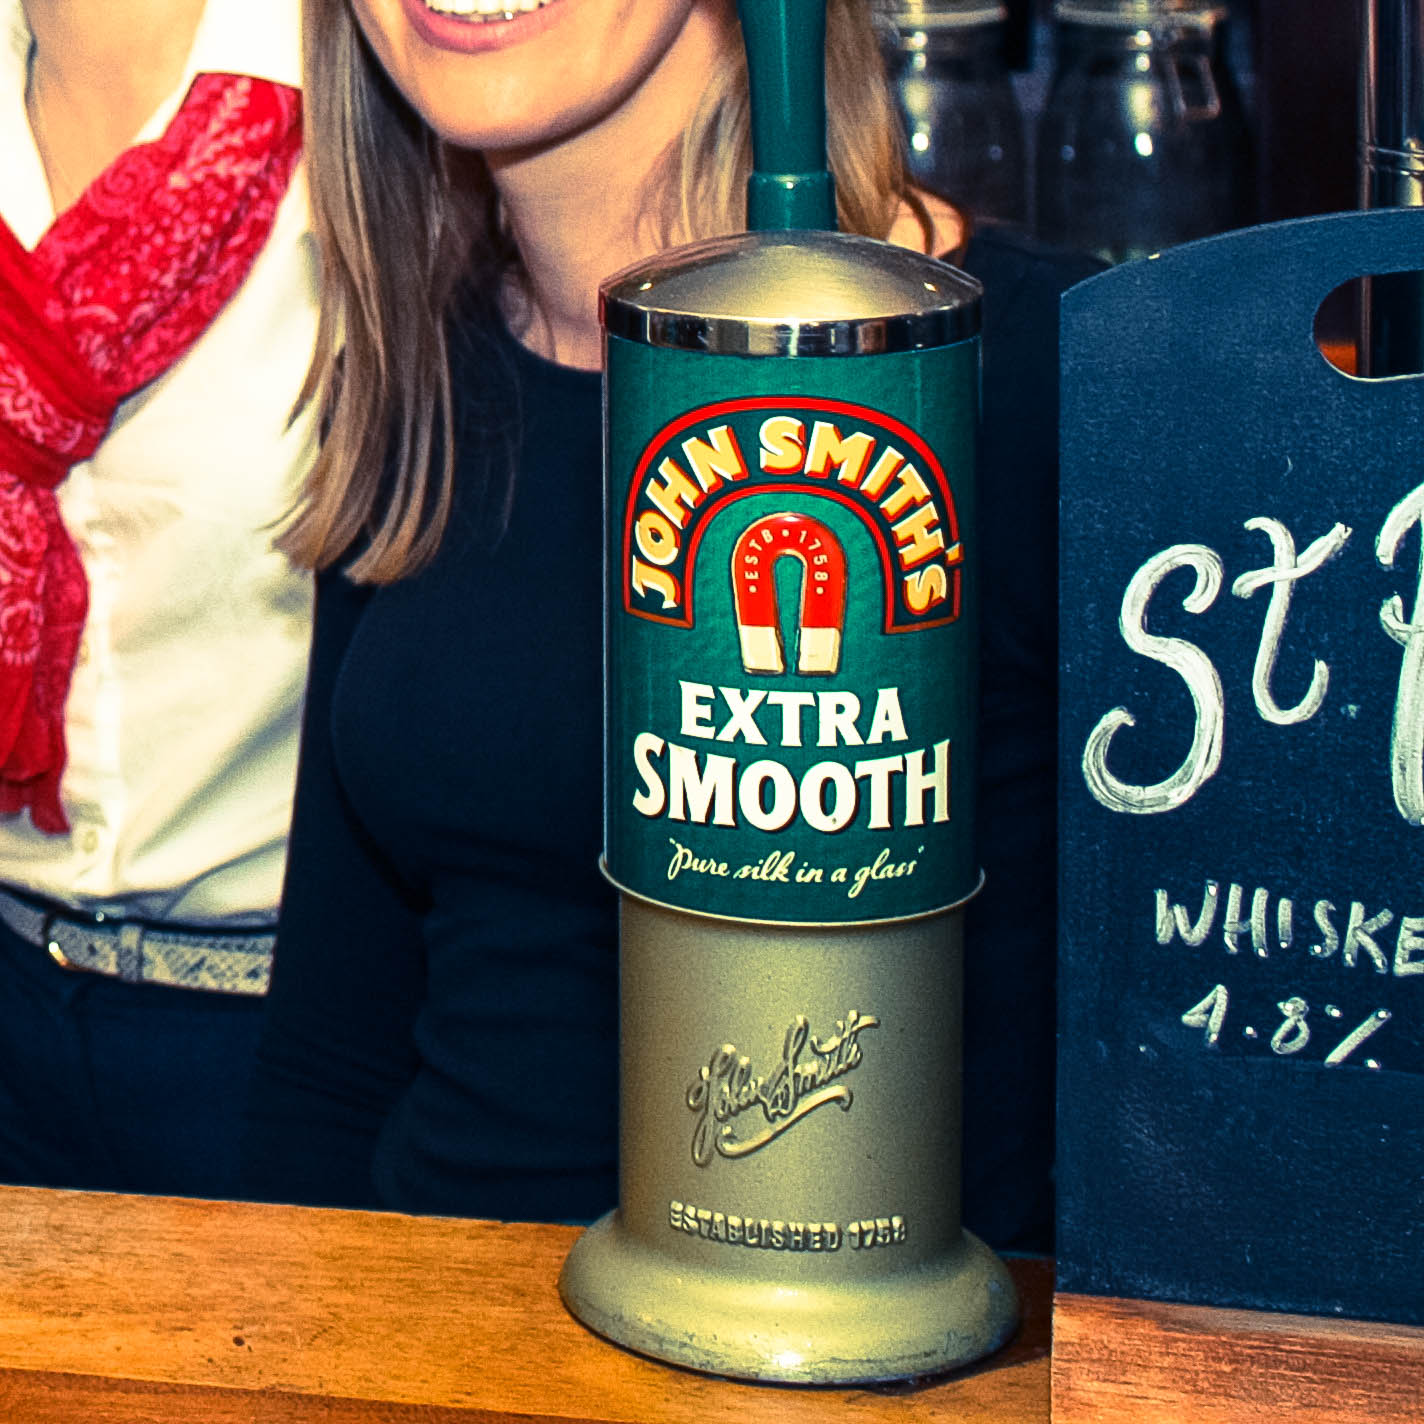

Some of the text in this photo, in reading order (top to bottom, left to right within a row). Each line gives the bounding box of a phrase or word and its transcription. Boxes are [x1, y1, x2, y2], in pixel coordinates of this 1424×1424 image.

[631, 416, 964, 615] JOHN SMITH'S
[744, 529, 829, 582] ESTB 1758
[678, 679, 909, 748] EXTRA
[632, 731, 951, 833] SMOOTH
[732, 850, 796, 884] silk
[795, 862, 823, 884] in
[830, 867, 848, 884] a
[669, 1201, 908, 1252] ESTABLISHED 1758
